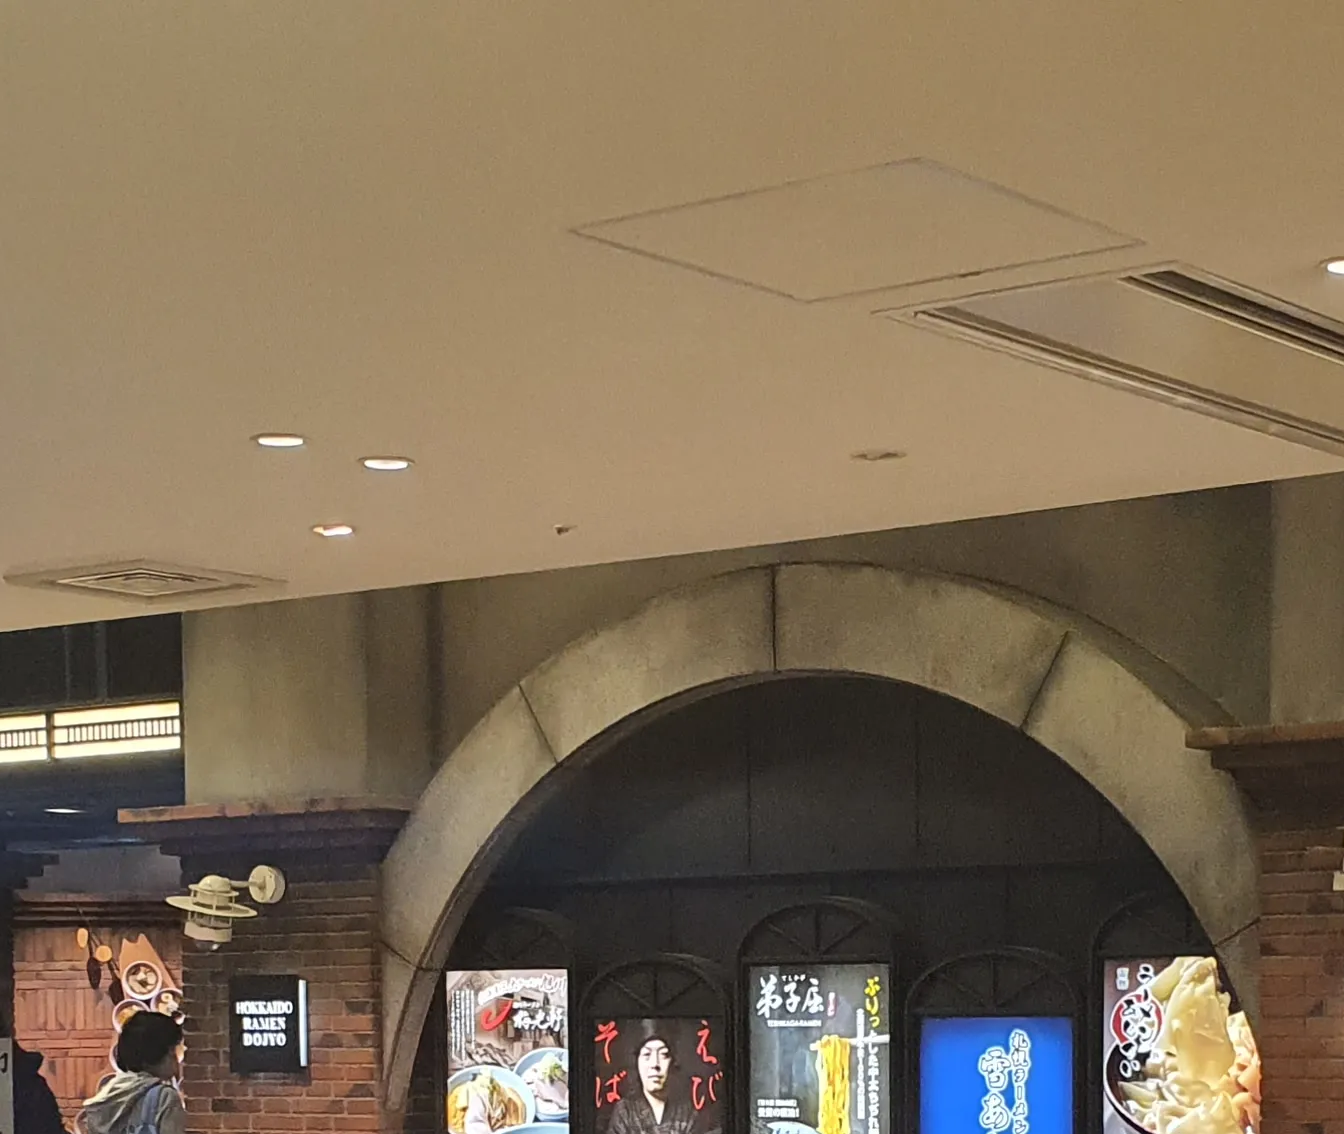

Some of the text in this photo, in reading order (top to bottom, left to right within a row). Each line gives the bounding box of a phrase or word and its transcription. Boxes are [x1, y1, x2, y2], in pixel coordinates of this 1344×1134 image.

[235, 1000, 294, 1015] HOKKAIDO
[756, 974, 824, 1018] 弟子屈
[242, 1017, 286, 1030] RAMEN
[242, 1033, 287, 1046] DOJYO
[594, 1020, 627, 1108] そば
[690, 1020, 723, 1110] えび
